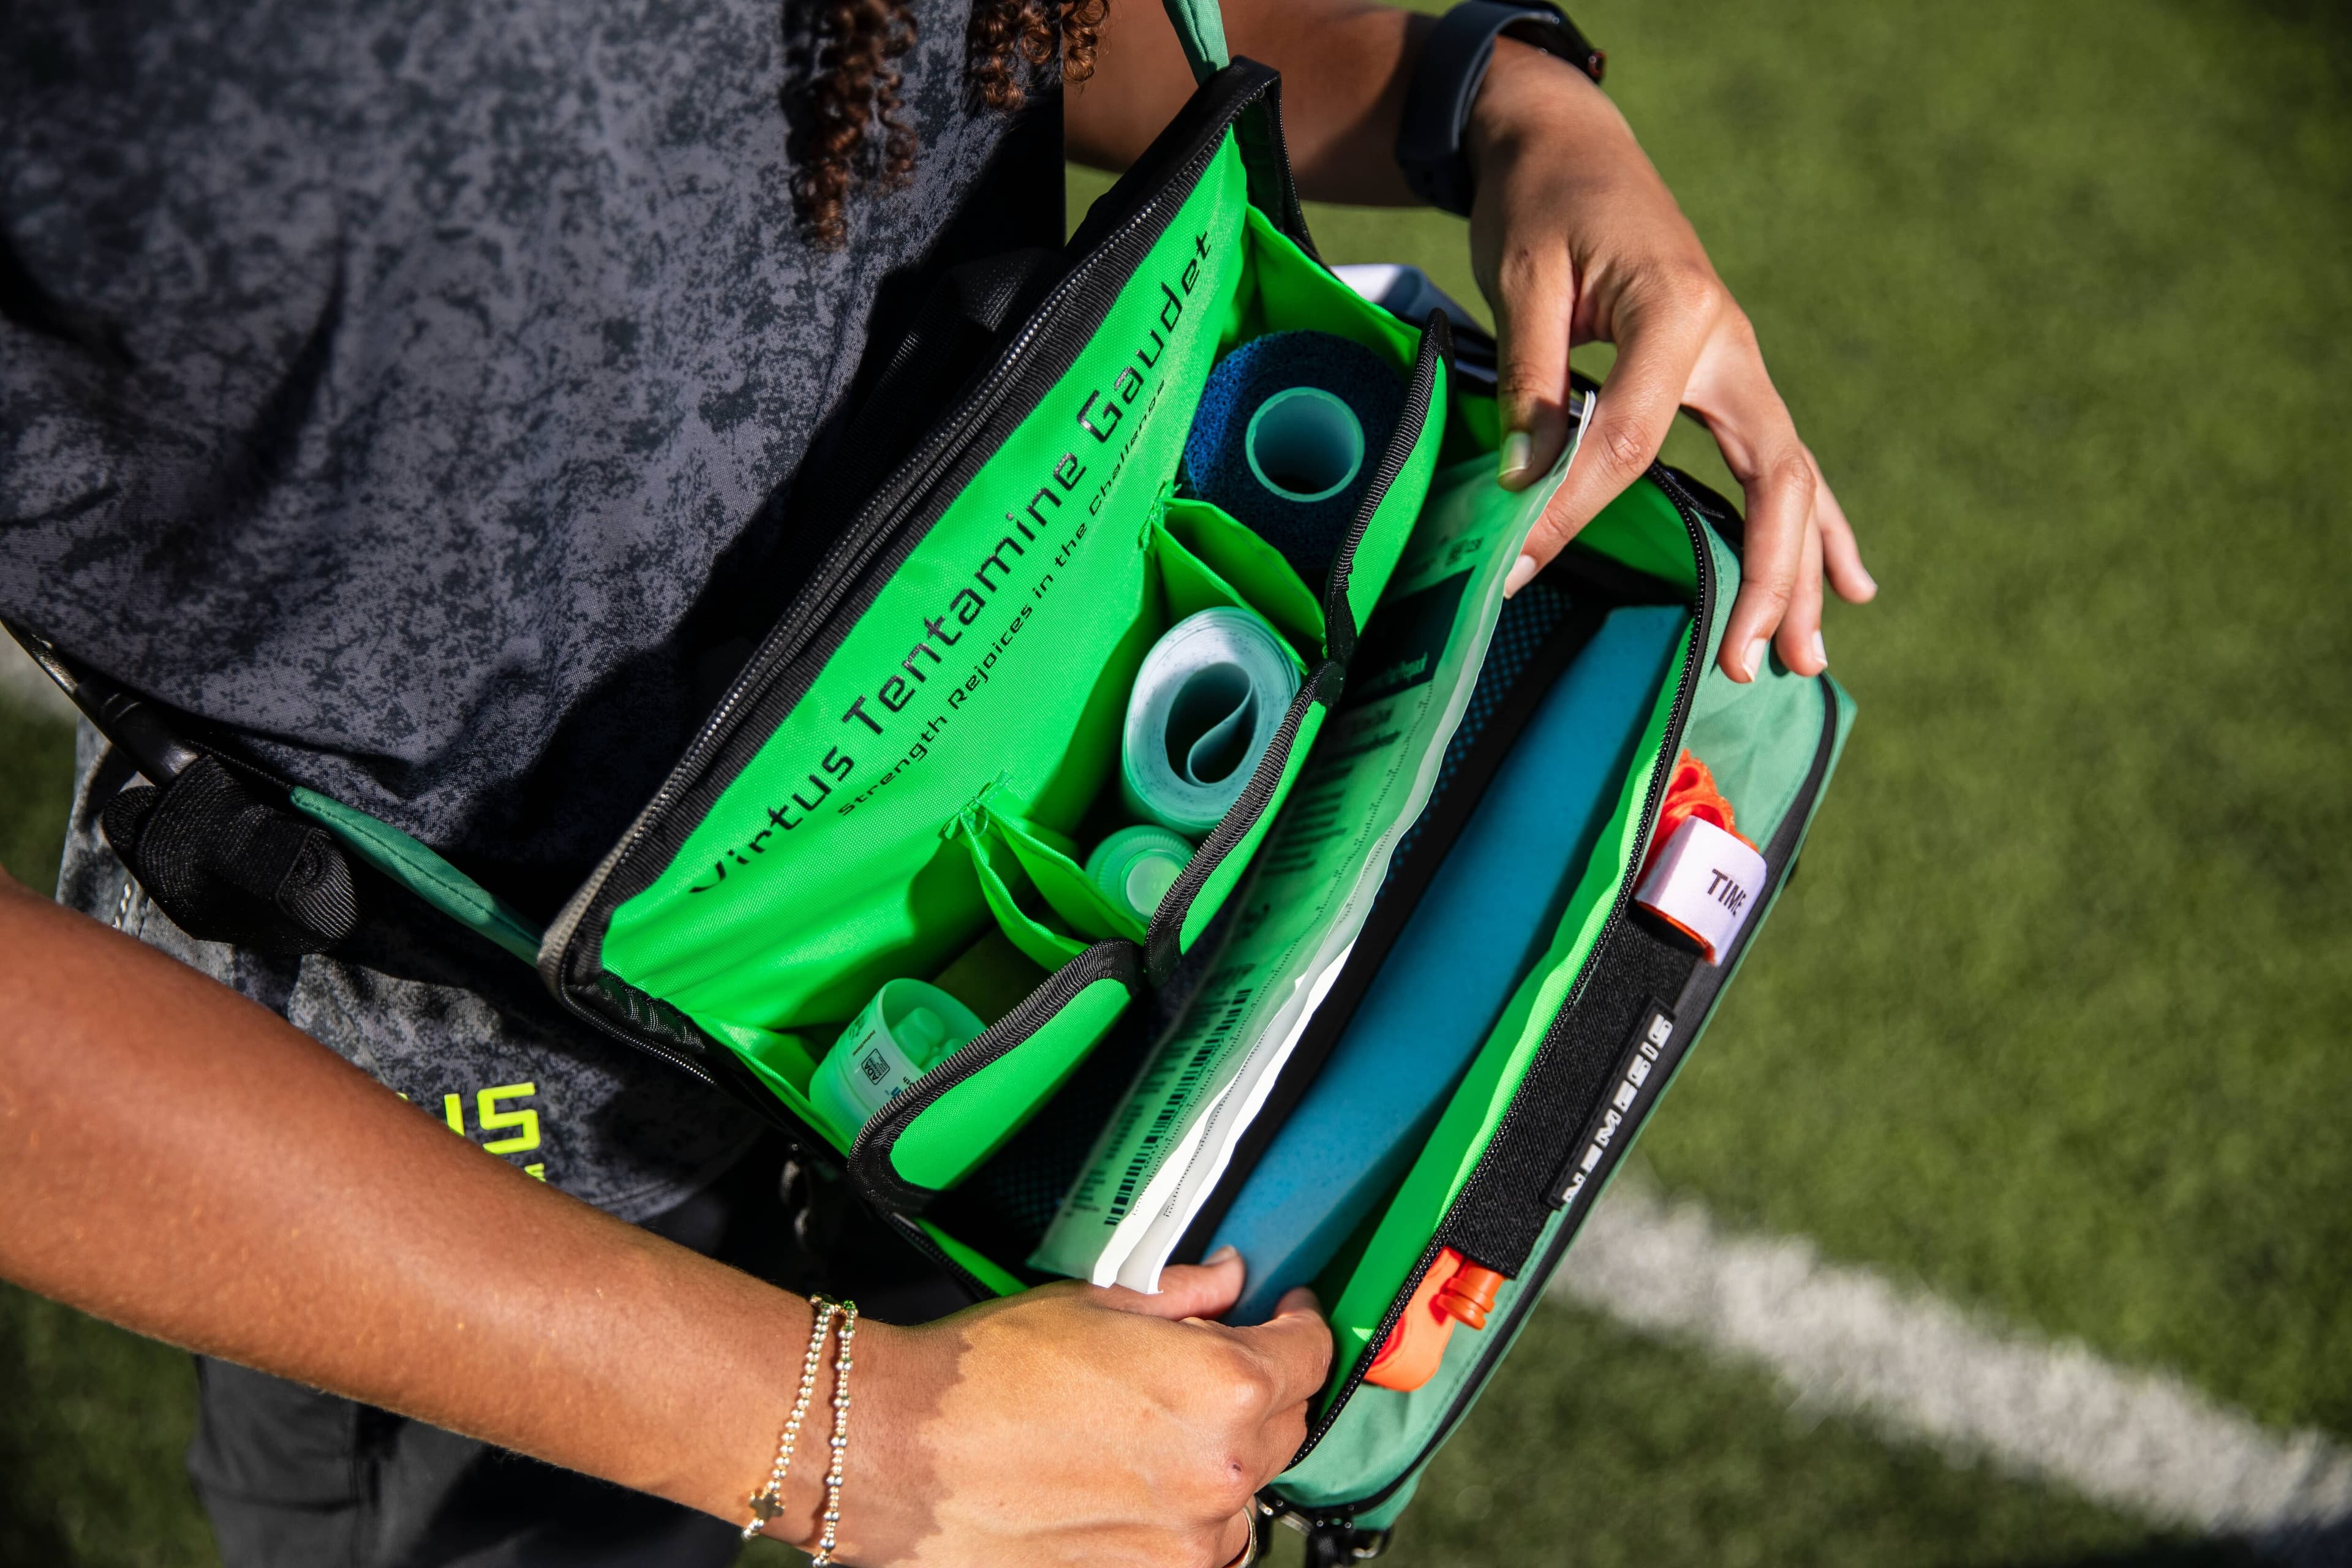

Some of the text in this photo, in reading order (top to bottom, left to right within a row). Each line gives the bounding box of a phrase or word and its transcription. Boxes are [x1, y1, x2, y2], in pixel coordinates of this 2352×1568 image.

[688, 230, 1212, 894] Virtus Tentamine Gaudet
[837, 378, 1166, 816] Strength Rejoices in the Challenge
[864, 1061, 879, 1080] ADA
[1562, 1013, 1673, 1204] NEMESIS
